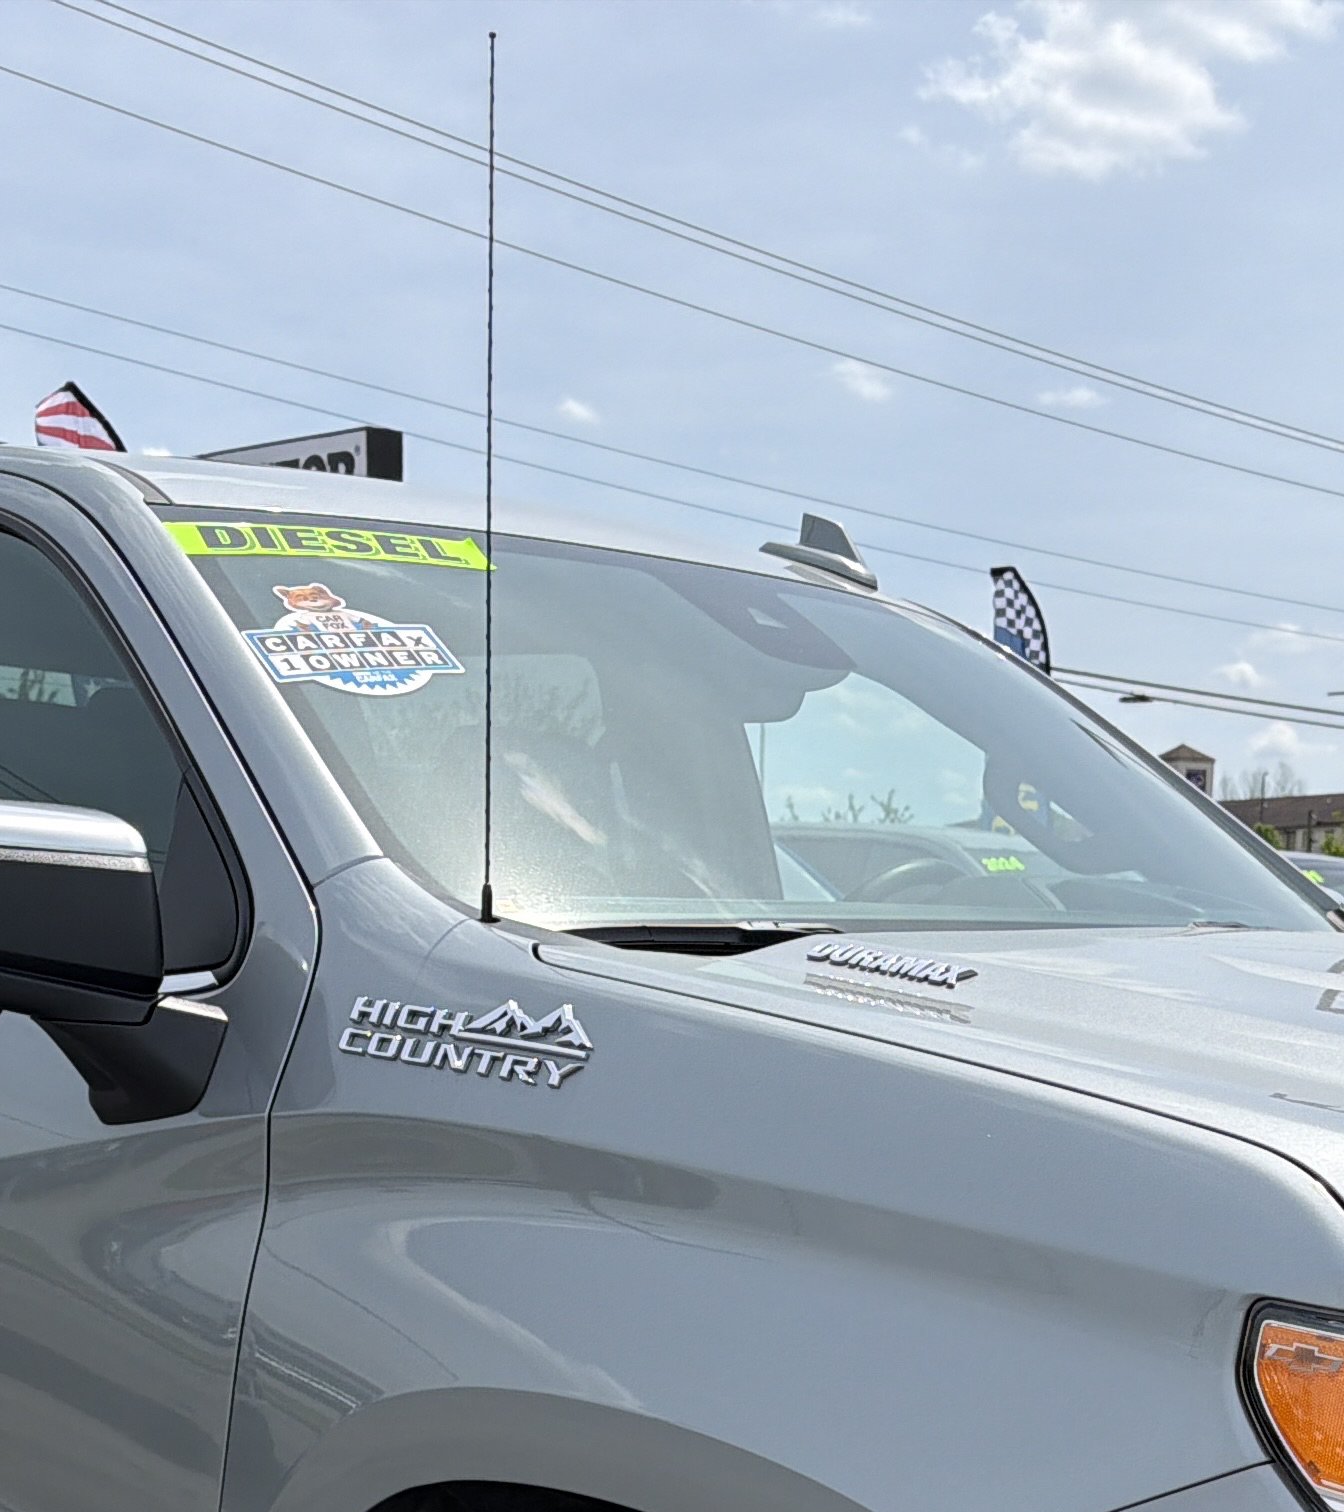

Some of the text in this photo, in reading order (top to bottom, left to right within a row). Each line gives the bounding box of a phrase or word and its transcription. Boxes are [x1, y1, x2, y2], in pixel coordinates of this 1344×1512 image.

[197, 525, 470, 565] DIESEL
[316, 614, 344, 624] CAR
[322, 622, 350, 631] FOX
[262, 631, 431, 651] CARFAX
[280, 651, 445, 672] 1 OWNER
[807, 943, 979, 989] DURAMAX
[348, 996, 471, 1037] HIGH
[338, 1027, 585, 1089] COUNTRY
